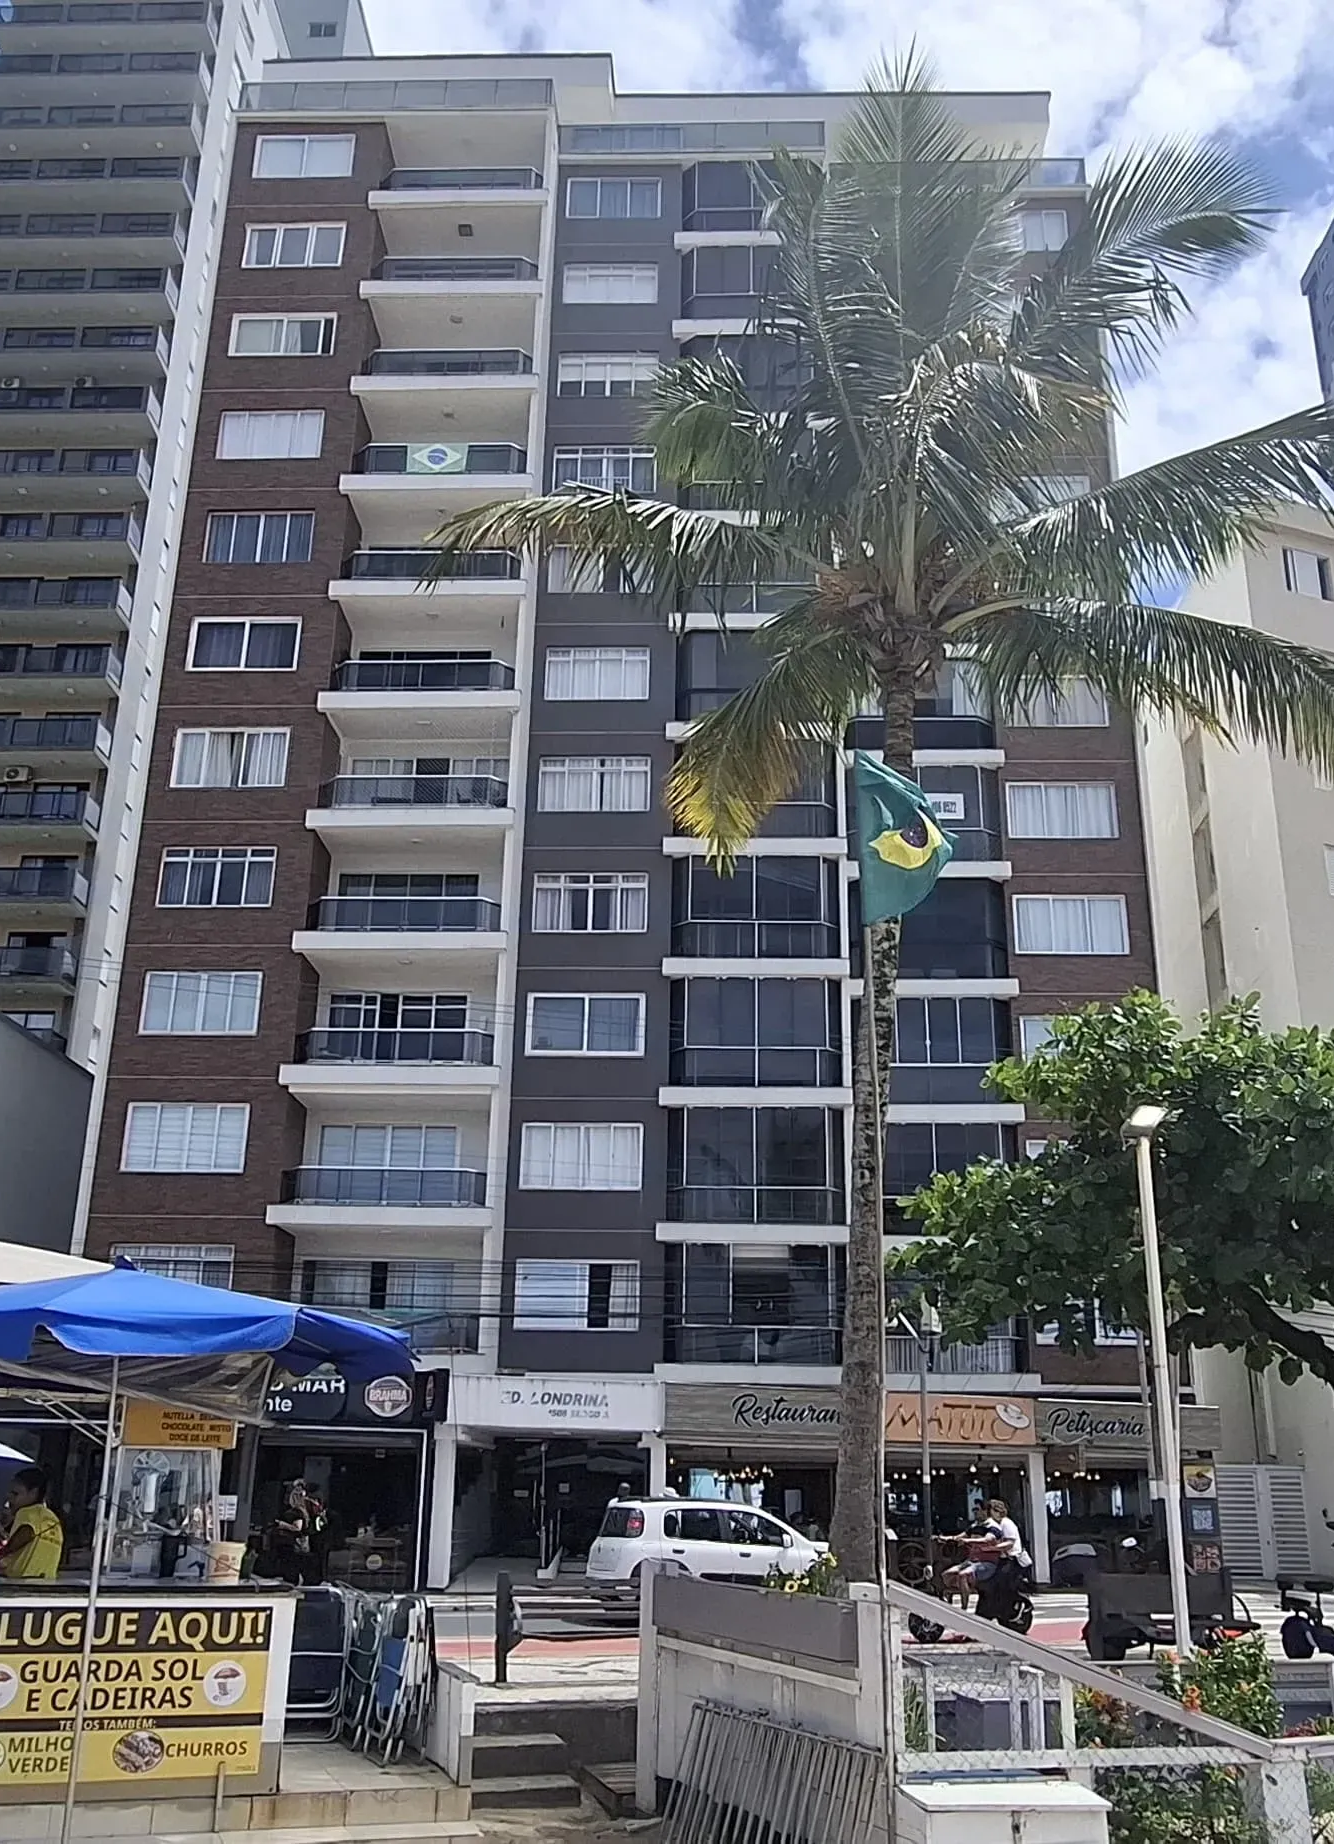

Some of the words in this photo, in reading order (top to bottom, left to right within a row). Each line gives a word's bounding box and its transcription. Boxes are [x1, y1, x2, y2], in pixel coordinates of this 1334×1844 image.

[370, 1389, 407, 1402] BRAHMA
[531, 1391, 608, 1407] LONDRINA
[161, 1422, 204, 1432] CHOCOLATE
[885, 1402, 1017, 1441] MATUTO
[1047, 1407, 1147, 1437] Petiscaria
[148, 1611, 268, 1651] AQUI!
[20, 1660, 143, 1683] GUARDA
[151, 1658, 204, 1682] SOL
[26, 1689, 42, 1712] E
[50, 1686, 194, 1712] CADEIRAS
[59, 1719, 100, 1731] TEOS
[103, 1716, 156, 1730] TAMBÉM:
[8, 1736, 74, 1753] MILHO
[166, 1741, 248, 1758] CHURROS
[8, 1757, 69, 1774] VERDE
